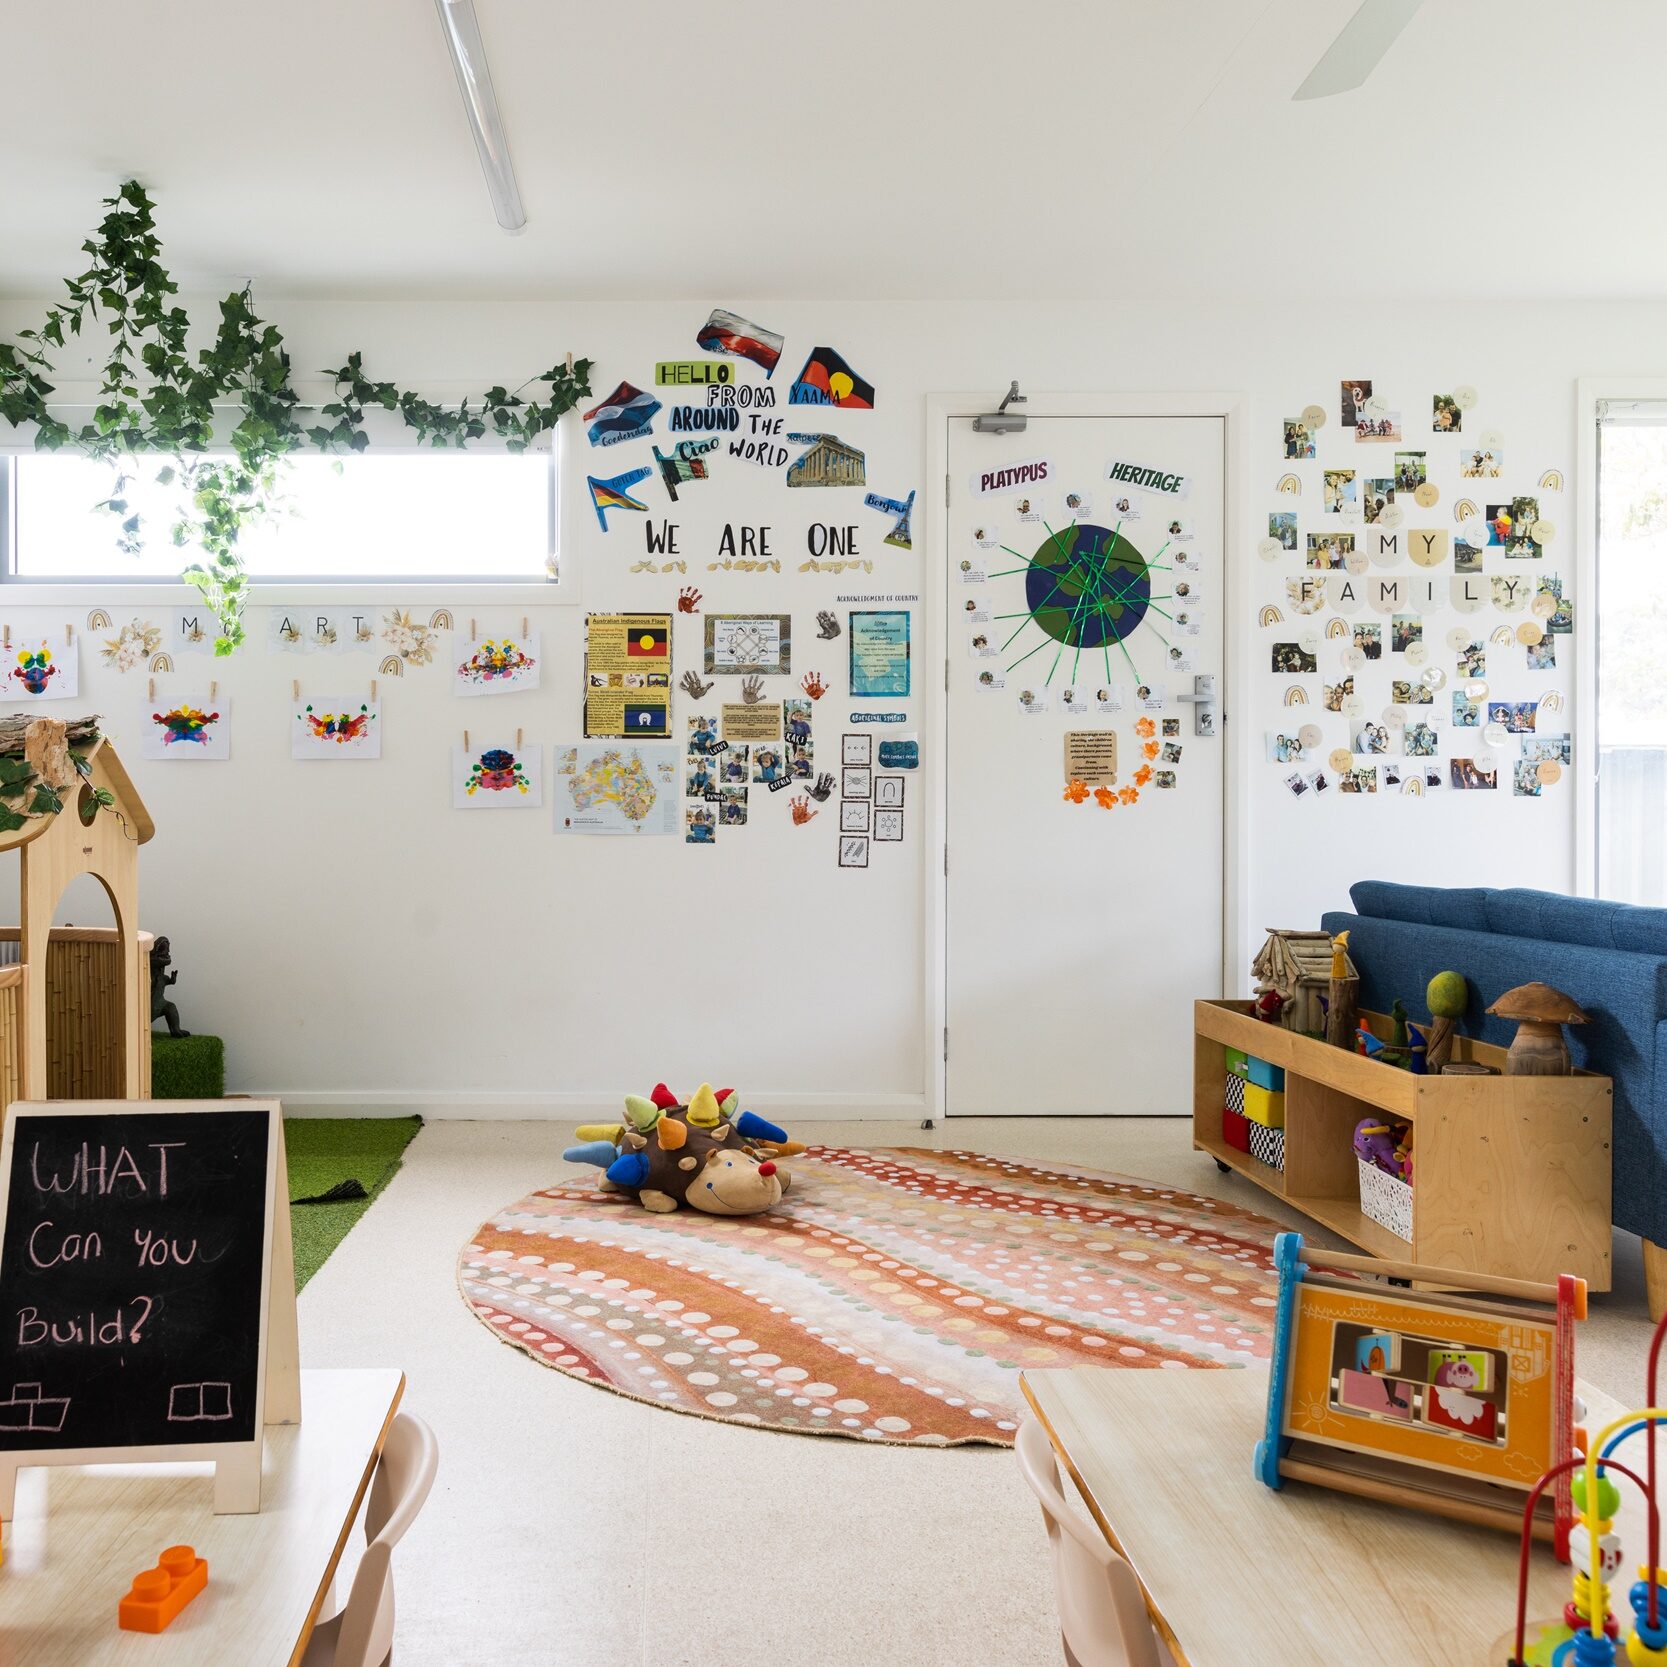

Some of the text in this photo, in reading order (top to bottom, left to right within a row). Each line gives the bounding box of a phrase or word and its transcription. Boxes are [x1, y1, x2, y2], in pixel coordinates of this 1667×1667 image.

[661, 364, 730, 384] HELLO
[707, 384, 776, 408] FROM
[789, 385, 841, 405] YAAMA
[672, 405, 784, 436] AROUND THE
[679, 438, 719, 461] Ciao
[729, 438, 789, 467] WORLD
[637, 466, 650, 478] TAG
[981, 461, 1048, 492] PLATYPUS
[1109, 462, 1184, 493] HERITAGE
[867, 494, 907, 513] Bonjour
[646, 519, 860, 557] WE ARE ONE
[1380, 534, 1436, 554] MY
[1302, 581, 1518, 602] FAMILY
[280, 617, 364, 634] ART
[621, 618, 650, 626] Indigenous
[651, 618, 667, 626] Flags
[30, 1141, 187, 1196] WHAT
[28, 1221, 102, 1269] Can
[16, 1295, 153, 1346] Build?
